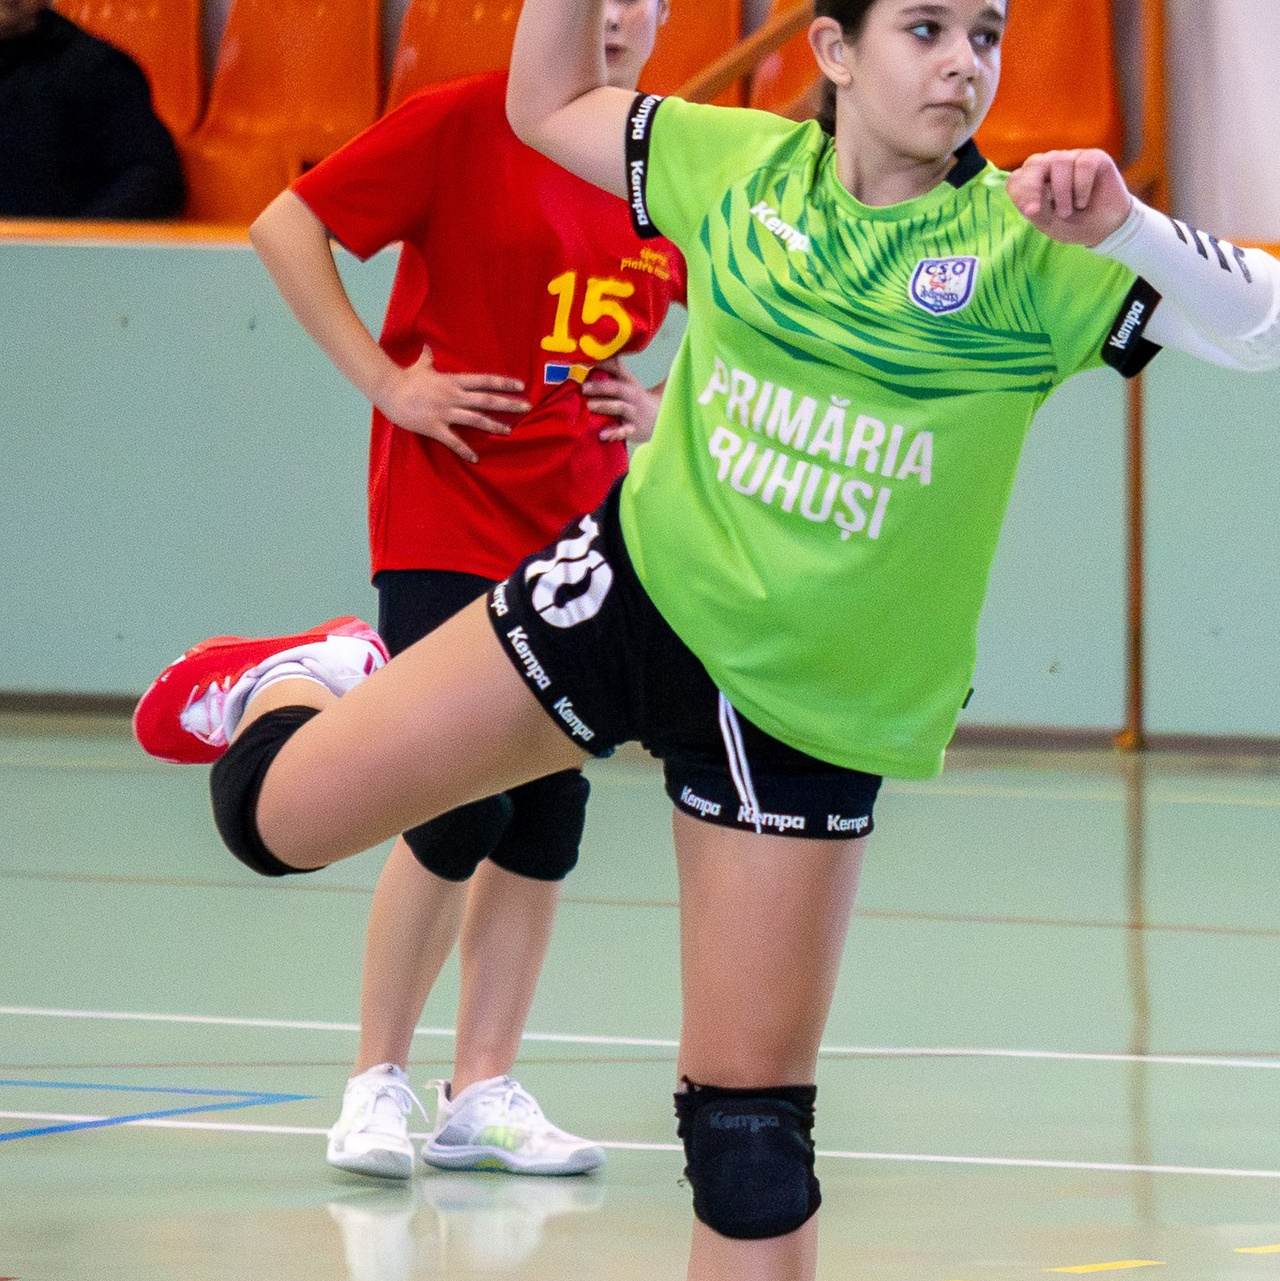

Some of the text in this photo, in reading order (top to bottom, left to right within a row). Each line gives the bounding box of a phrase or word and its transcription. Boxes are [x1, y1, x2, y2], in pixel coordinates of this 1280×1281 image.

[630, 160, 649, 226] Kempa
[540, 271, 635, 360] 15
[1109, 300, 1145, 350] Kempa
[697, 356, 934, 485] PRIMĂRIA
[507, 626, 551, 691] Kempa
[553, 696, 596, 742] Kempa
[680, 786, 722, 817] Kempa
